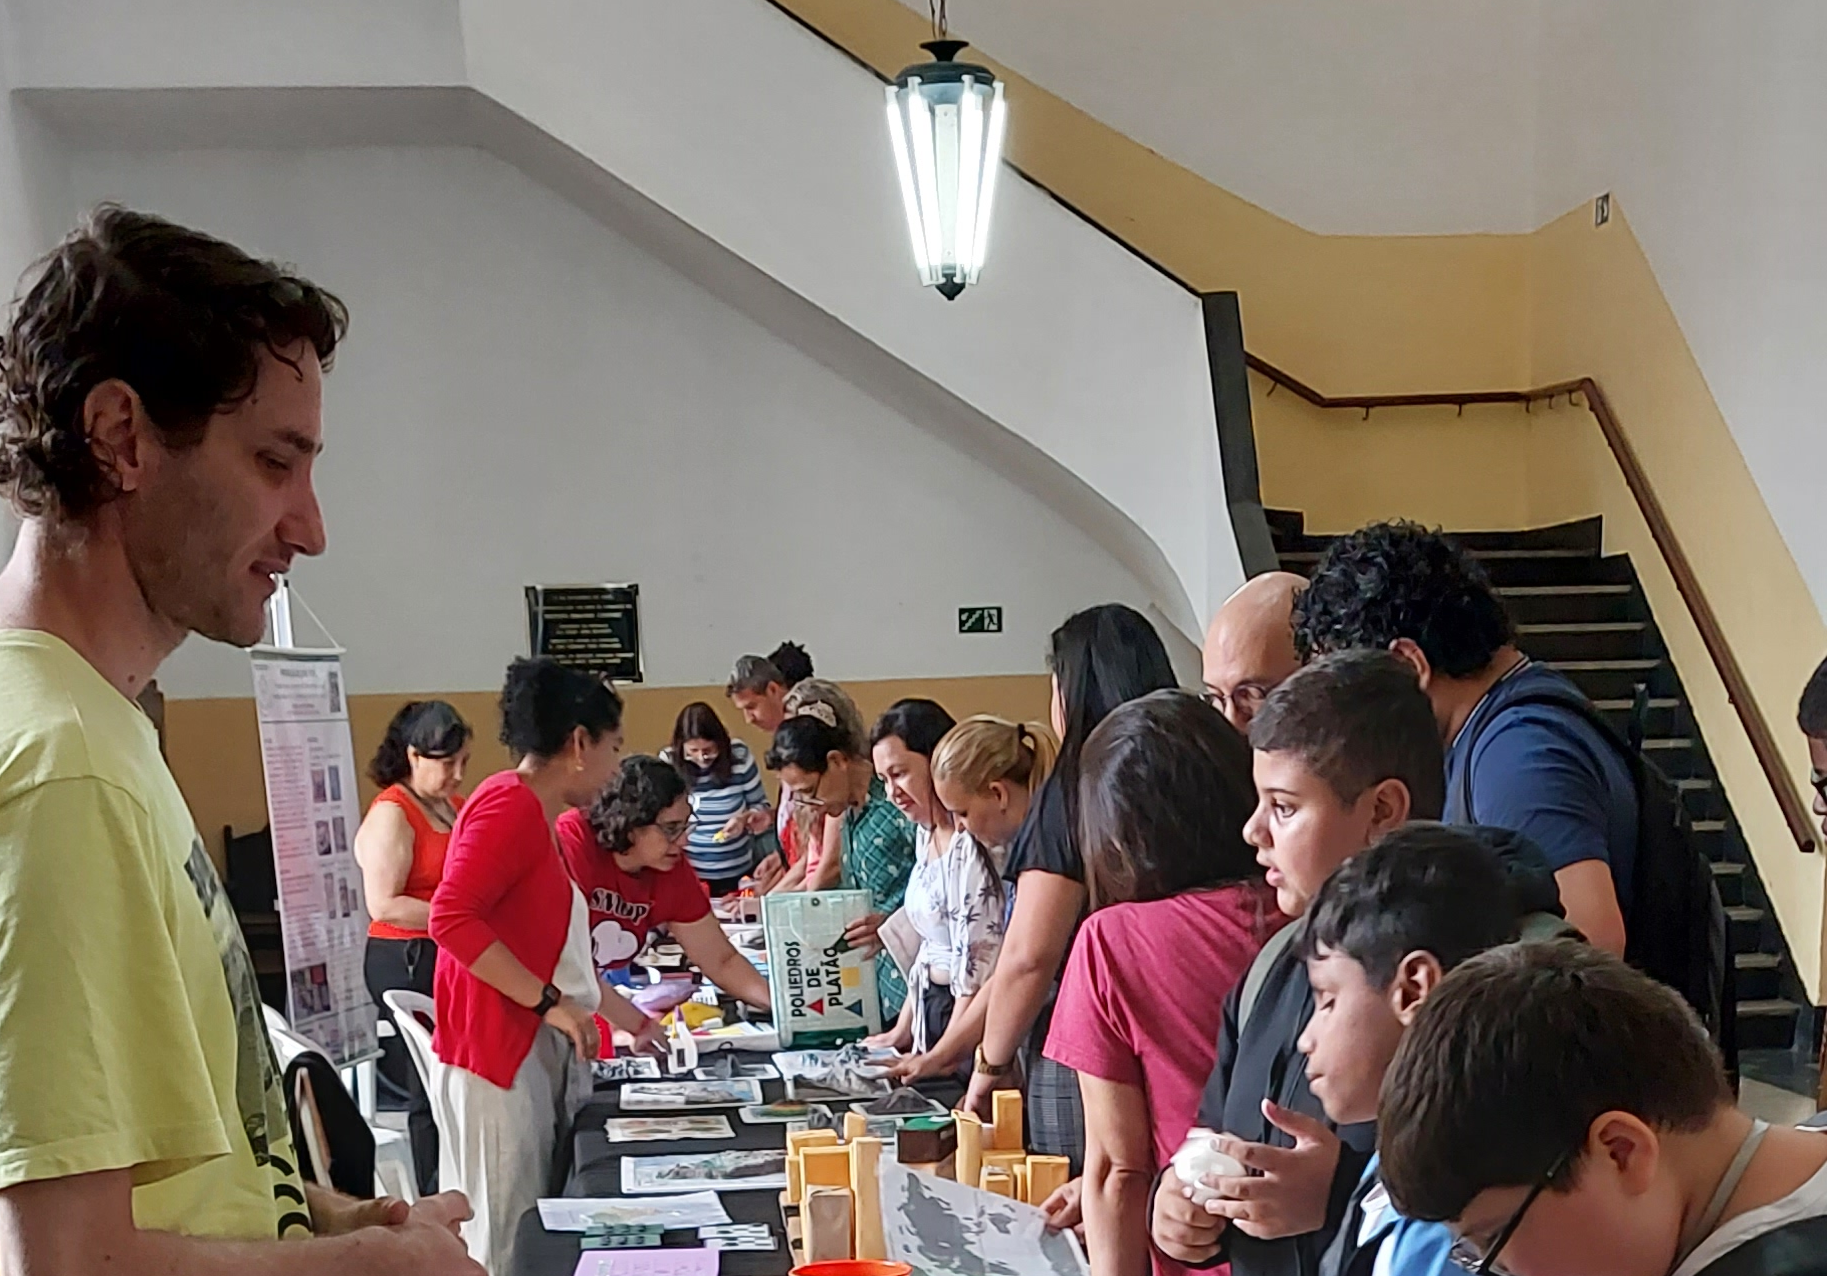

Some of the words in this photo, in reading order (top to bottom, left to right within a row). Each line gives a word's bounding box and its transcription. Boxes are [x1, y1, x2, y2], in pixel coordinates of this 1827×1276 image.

[784, 941, 807, 1018] POLIEDROS
[805, 967, 821, 988] DE
[821, 946, 844, 1007] PLATÃO
